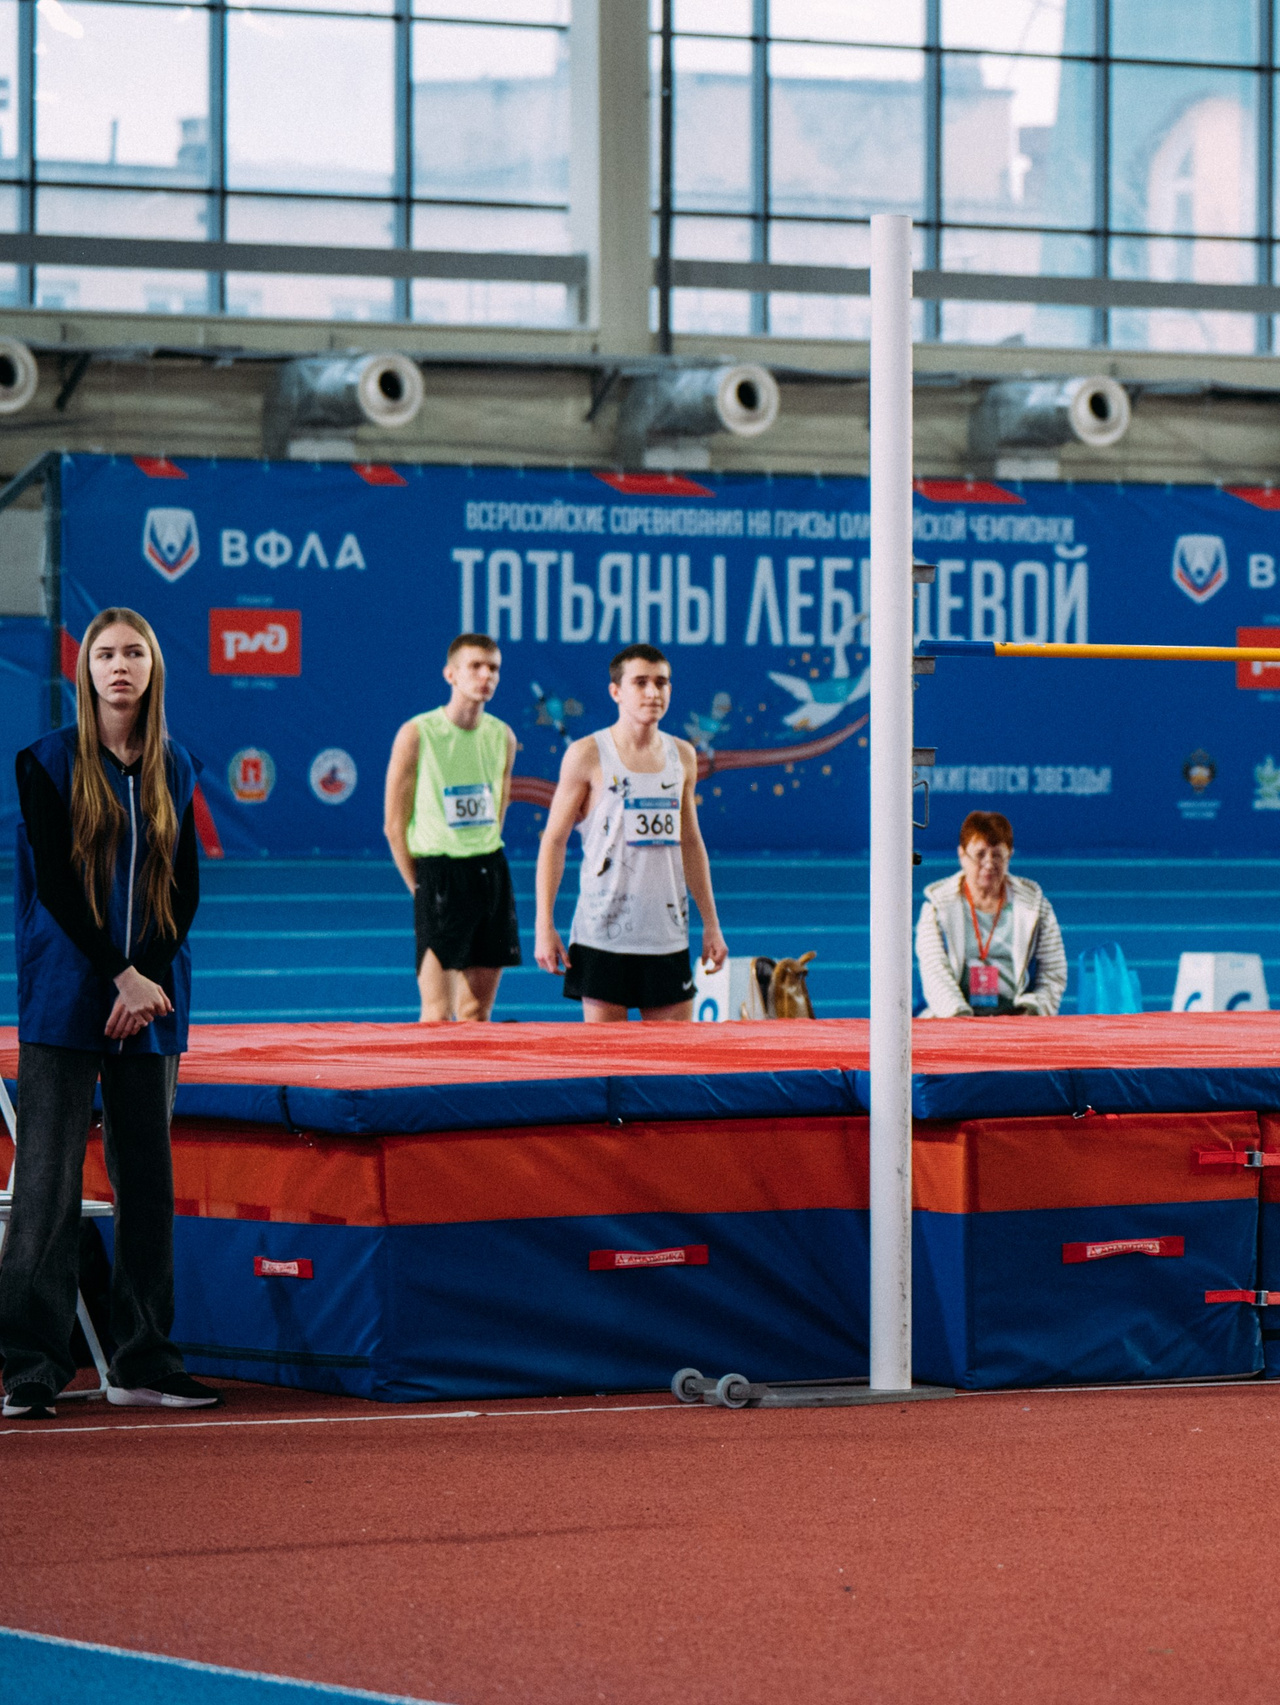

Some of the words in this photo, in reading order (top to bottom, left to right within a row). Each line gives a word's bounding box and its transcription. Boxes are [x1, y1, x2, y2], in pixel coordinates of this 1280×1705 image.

[747, 509, 772, 537] НА
[775, 510, 837, 540] ПРИЗЫ
[221, 529, 367, 570] ВФЛА
[452, 548, 726, 645] ТАТЬЯНЫ
[636, 814, 674, 835] 368
